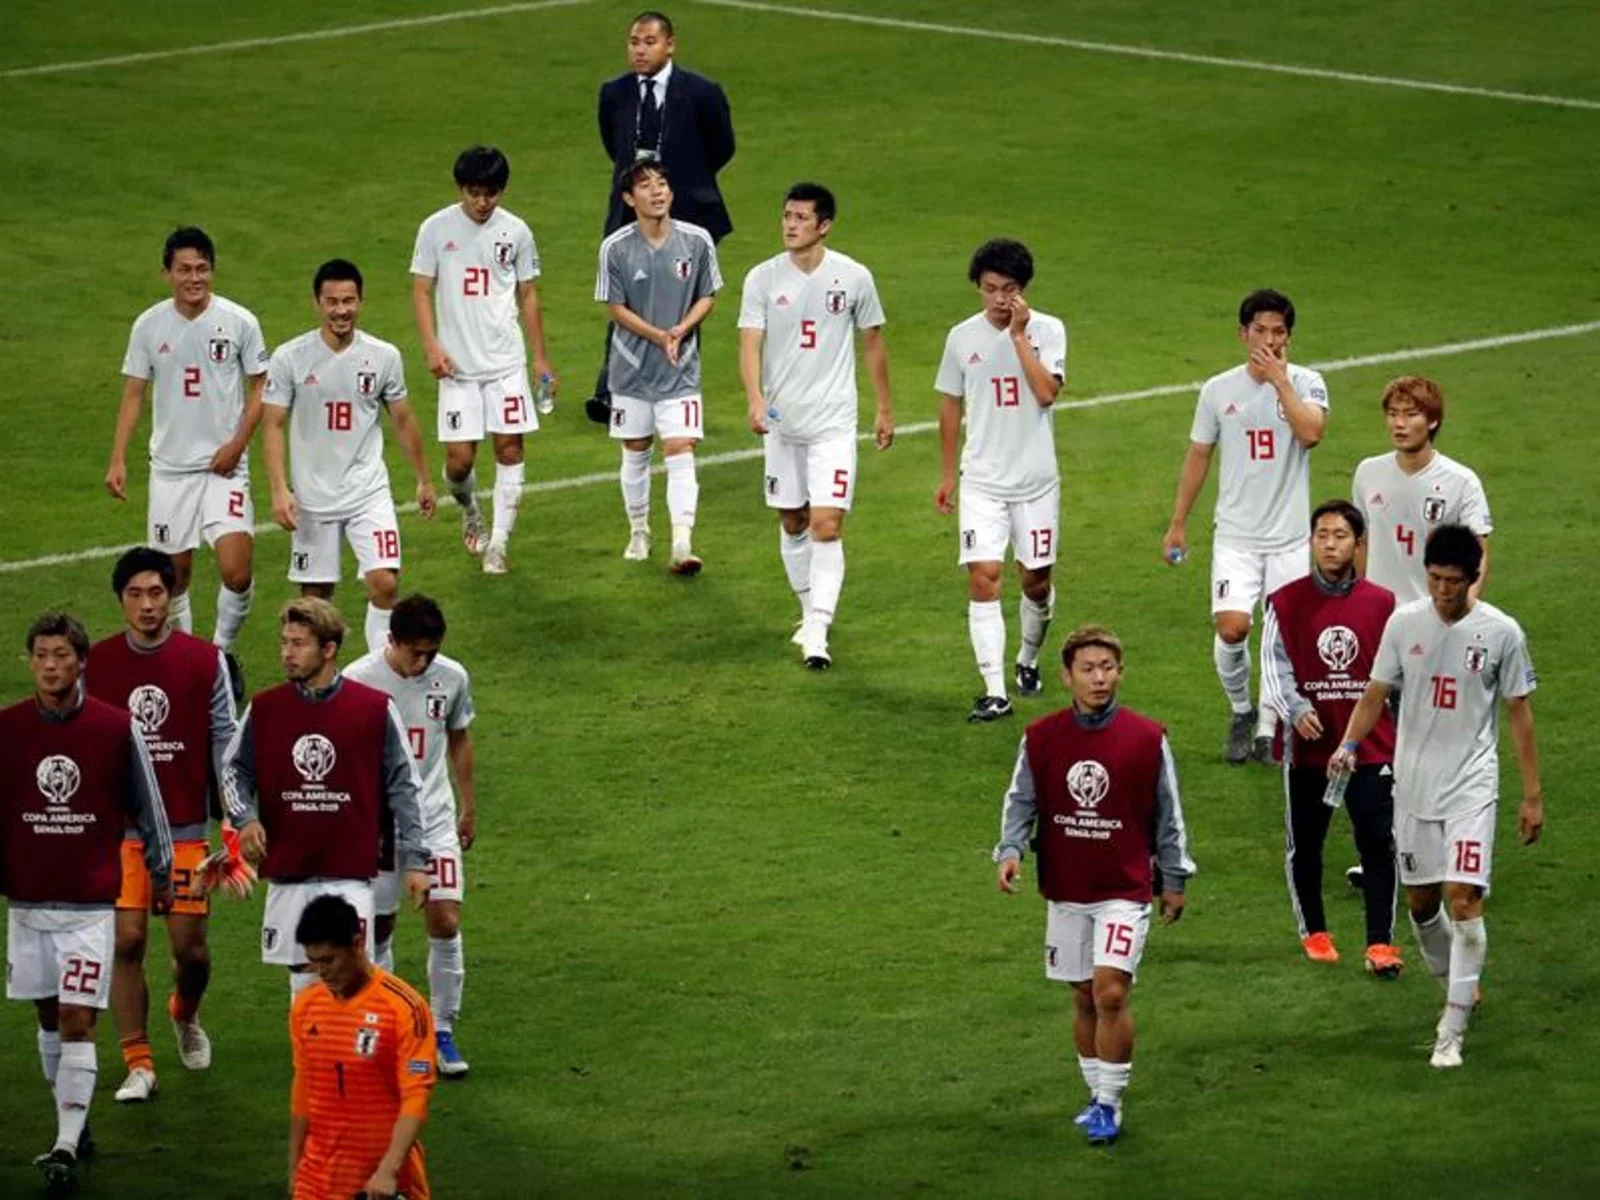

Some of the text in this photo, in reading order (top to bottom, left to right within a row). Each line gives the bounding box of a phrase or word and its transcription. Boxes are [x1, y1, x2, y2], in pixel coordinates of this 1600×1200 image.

[464, 267, 489, 296] 21
[799, 320, 817, 348] 5
[184, 368, 200, 396] 2
[992, 377, 1020, 406] 13
[325, 402, 352, 430] 18
[503, 396, 527, 424] 21
[681, 400, 700, 427] 11
[1246, 430, 1274, 459] 19
[832, 469, 849, 498] 5
[228, 491, 245, 518] 2
[373, 530, 400, 559] 18
[1031, 529, 1052, 558] 13
[1396, 525, 1414, 555] 4
[1304, 681, 1370, 691] COPA AMERIC
[1432, 676, 1457, 709] 16
[281, 791, 351, 802] COPA AMERICA
[22, 812, 97, 823] COPA AMERICA
[1053, 814, 1123, 830] COPA AMERICA
[1456, 840, 1481, 873] 16
[1106, 923, 1134, 957] 15
[63, 959, 101, 995] 22
[335, 1062, 345, 1098] 1
